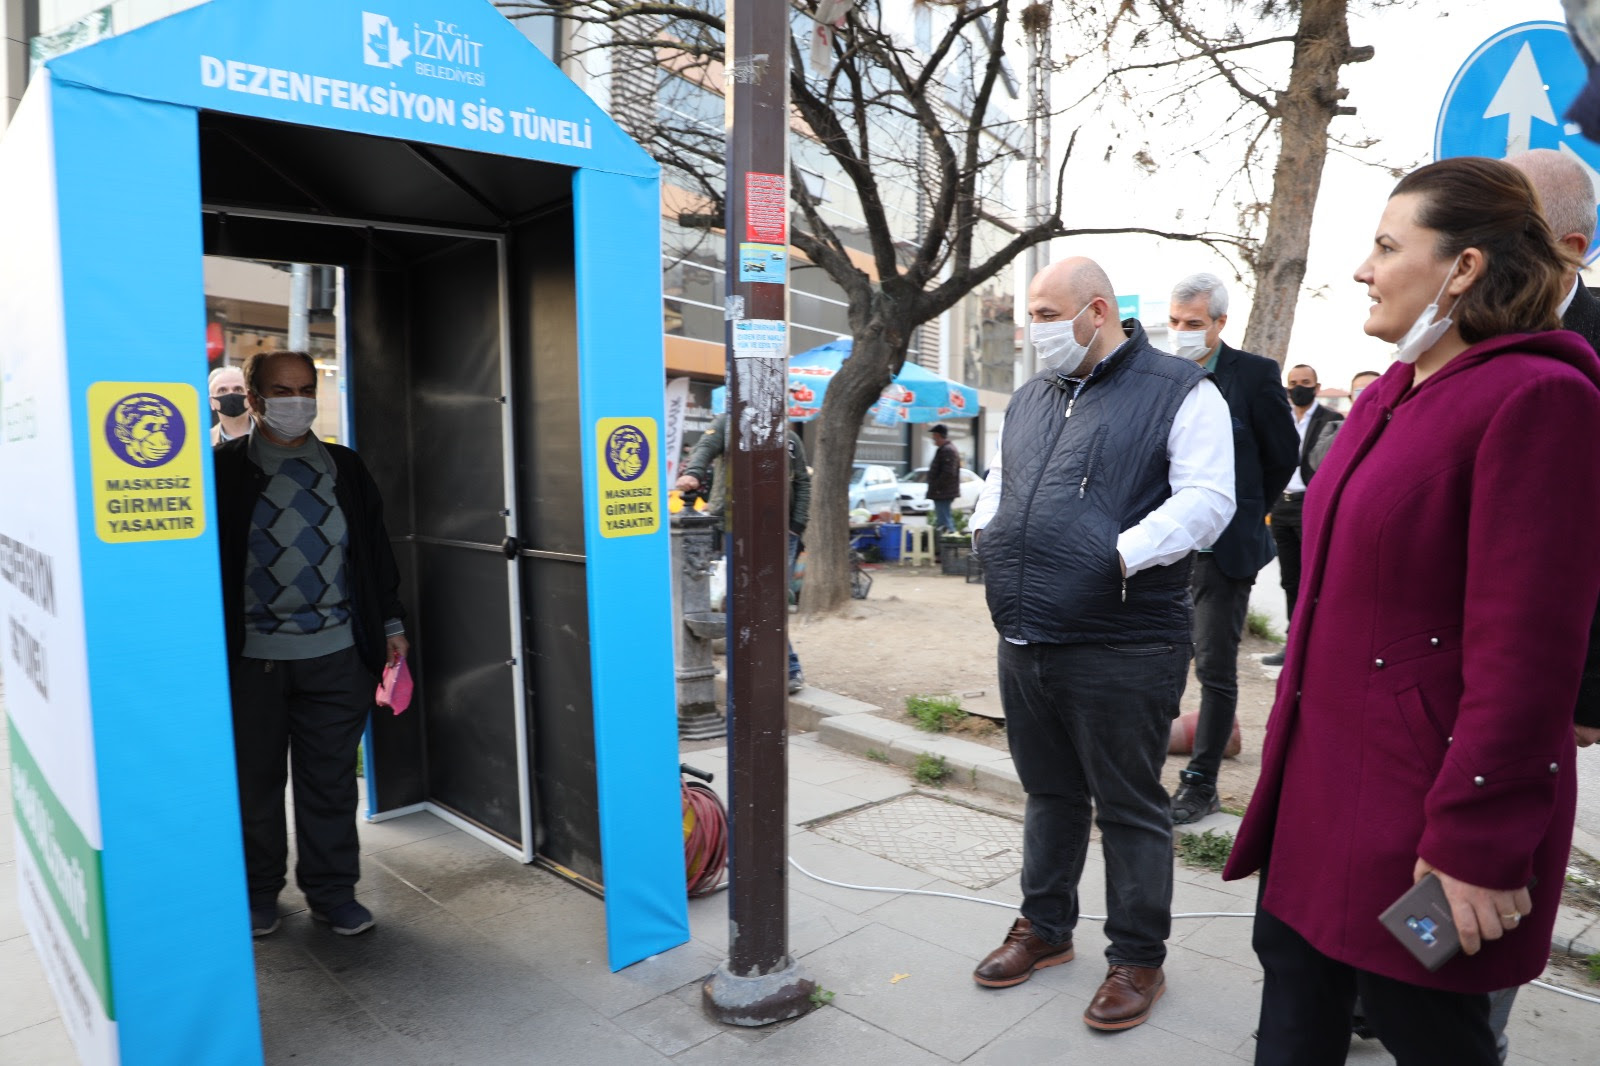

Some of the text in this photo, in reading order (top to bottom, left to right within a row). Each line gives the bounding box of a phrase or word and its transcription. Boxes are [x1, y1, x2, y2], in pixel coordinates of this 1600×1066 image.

[413, 22, 483, 67] İZMİT
[415, 60, 486, 87] BELEDİYESİ
[200, 54, 593, 150] DEZENFEKSİYON SİS TÜNELİ
[106, 475, 191, 491] MASKESİZ
[605, 486, 652, 499] MASKESİZ
[107, 495, 192, 514] GİRMEK
[605, 502, 653, 516] GİRMEK
[107, 517, 194, 533] YASAKTIR
[605, 517, 655, 531] YASAKTIR
